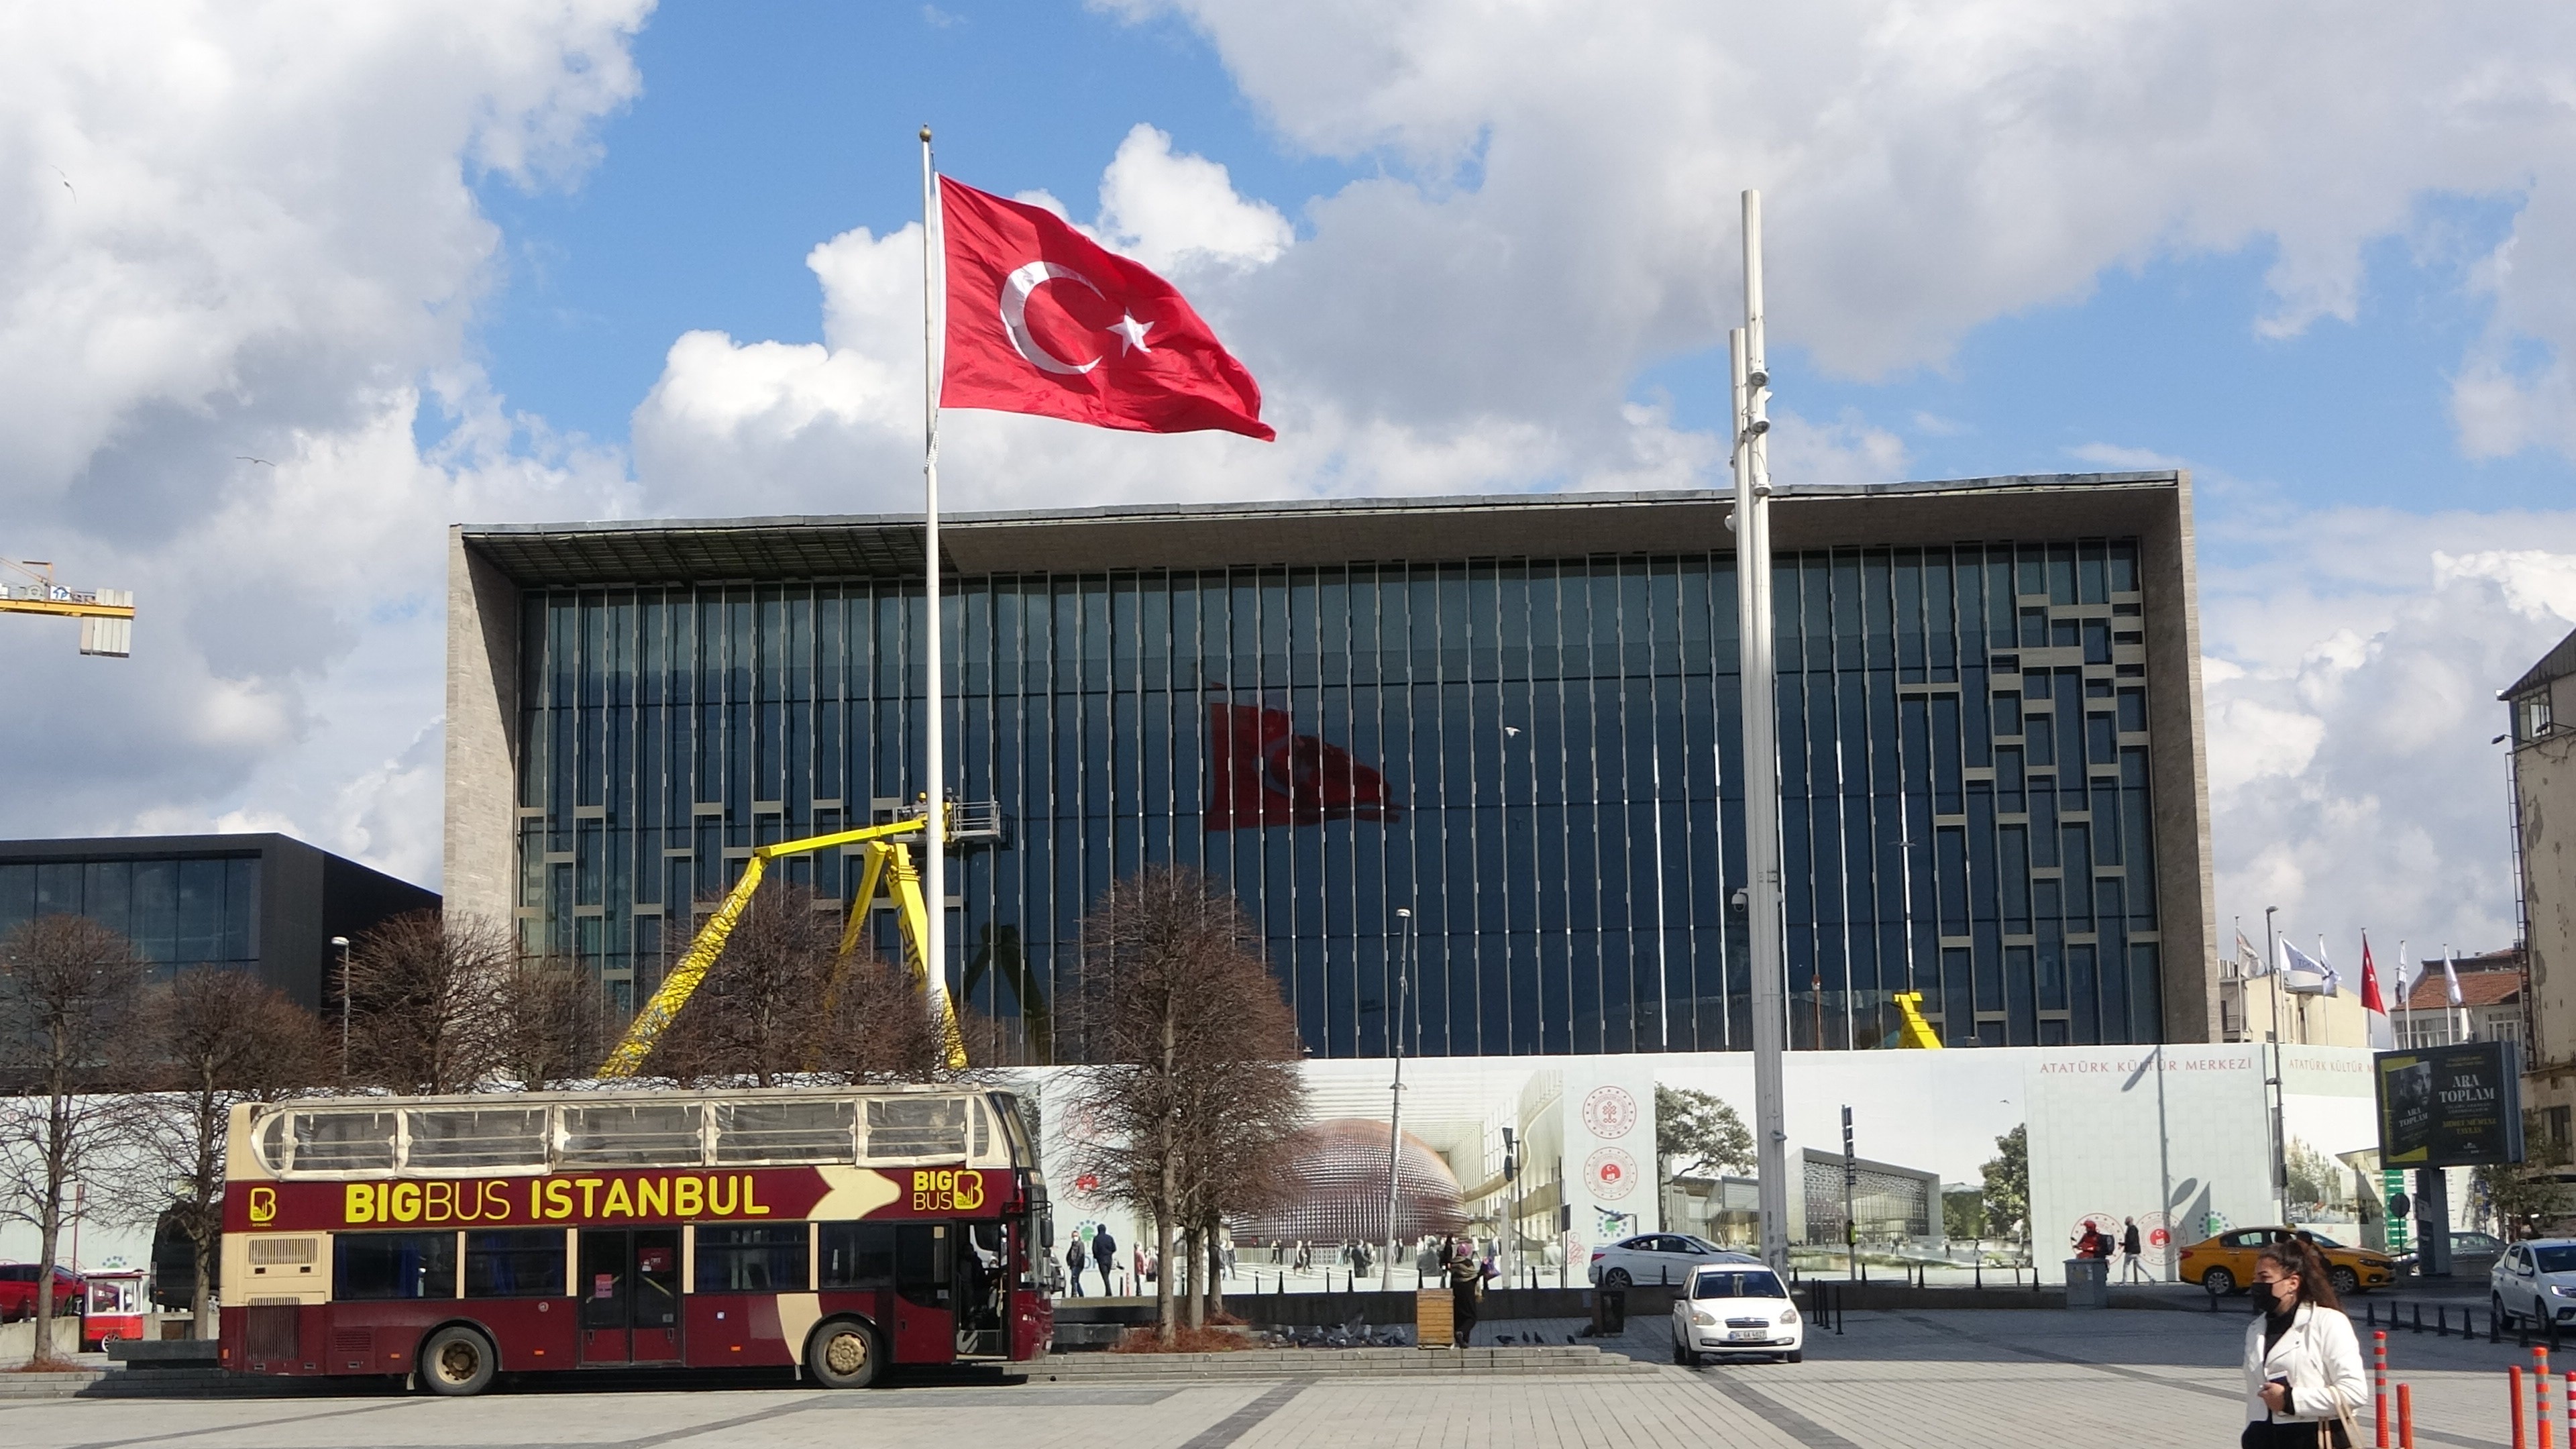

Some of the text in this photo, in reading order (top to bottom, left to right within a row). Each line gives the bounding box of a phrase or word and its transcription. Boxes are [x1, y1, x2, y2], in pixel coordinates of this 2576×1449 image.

[2040, 1057, 2252, 1073] ATATÜRK KÜLTÜR MERKEZİ
[2289, 1058, 2326, 1071] ATATÜRK
[2330, 1060, 2363, 1072] KÜLTÜR
[2453, 1074, 2479, 1087] ARA
[2438, 1087, 2495, 1103] TOPLAM
[2399, 1112, 2428, 1127] TOPLAM
[914, 1171, 952, 1191] BIG
[531, 1175, 770, 1219] ISTANBUL
[914, 1191, 952, 1210] BUS
